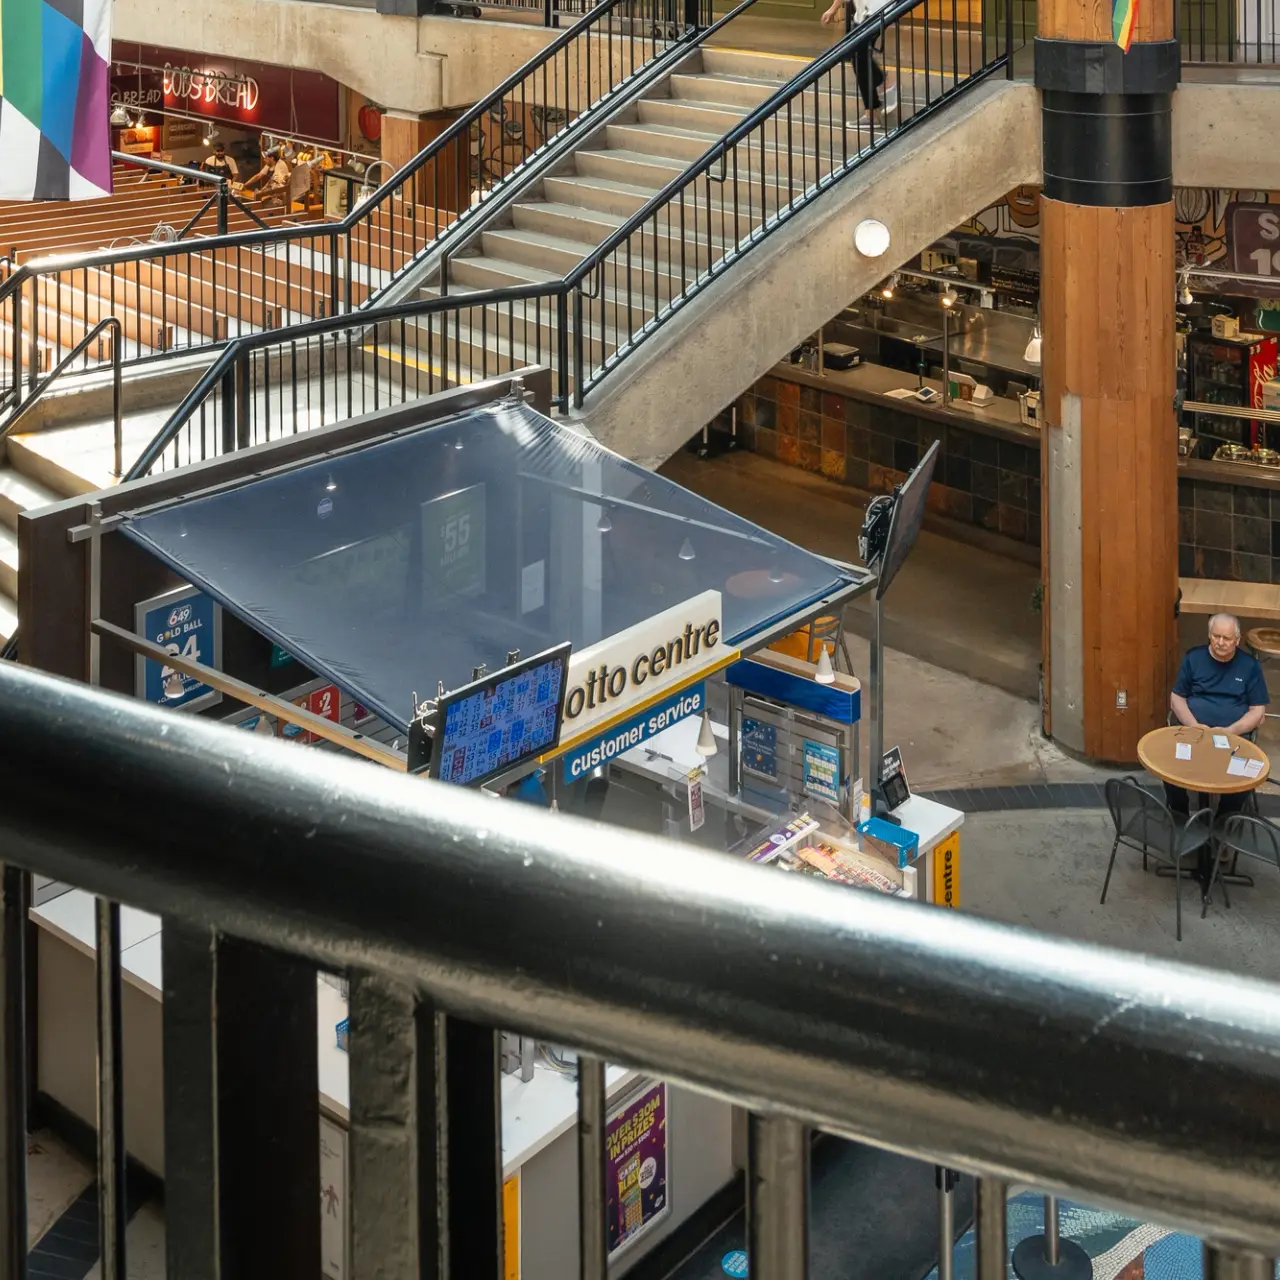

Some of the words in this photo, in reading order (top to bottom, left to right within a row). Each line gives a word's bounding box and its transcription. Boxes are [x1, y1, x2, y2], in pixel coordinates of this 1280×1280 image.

[123, 89, 161, 105] BREAD
[203, 69, 259, 110] BREAD
[440, 513, 471, 552] $55
[169, 608, 190, 625] 649
[183, 618, 203, 634] BALL
[565, 663, 627, 719] otto
[631, 618, 720, 686] centre
[319, 691, 332, 712] $2
[571, 720, 646, 777] customer
[648, 692, 701, 734] service
[606, 1121, 632, 1151] OVER
[632, 1094, 661, 1124] $30M
[610, 1138, 621, 1160] IN
[621, 1112, 655, 1152] PRIZES
